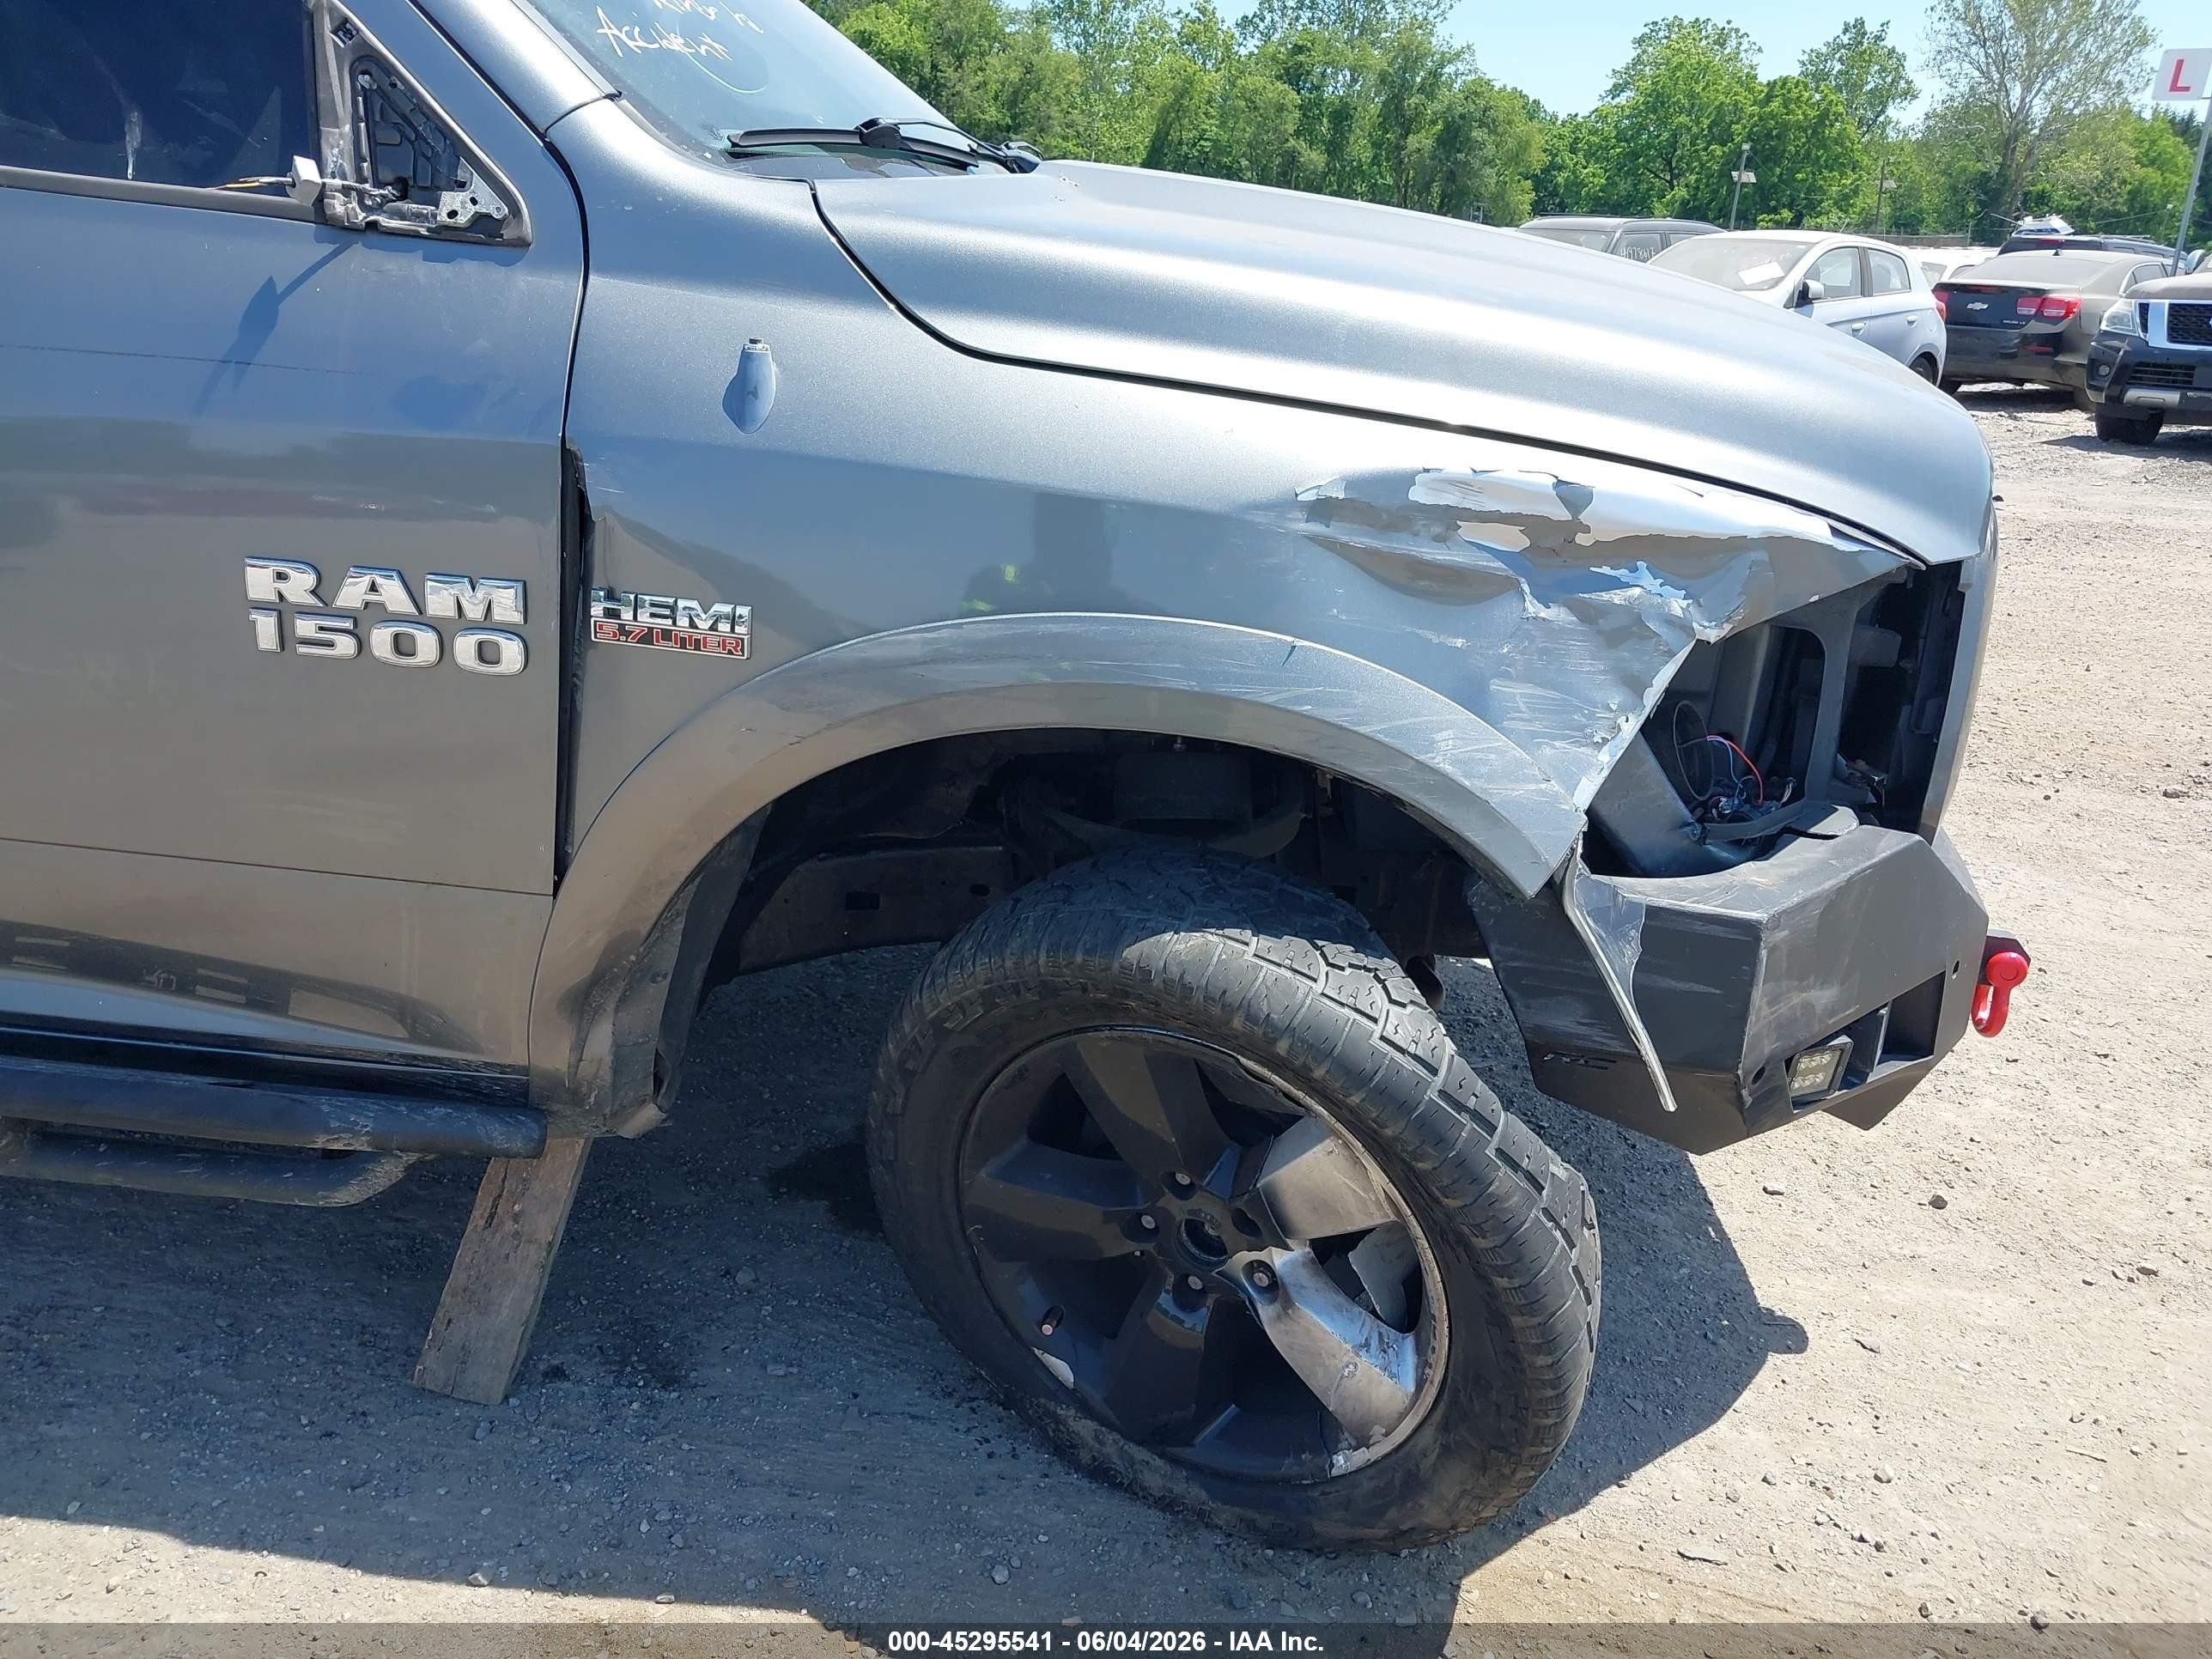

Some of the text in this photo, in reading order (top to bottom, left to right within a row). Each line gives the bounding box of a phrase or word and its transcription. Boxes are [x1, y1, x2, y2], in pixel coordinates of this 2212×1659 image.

[2168, 58, 2191, 93] L
[245, 556, 526, 625] RAM
[590, 588, 753, 634] HEMI
[248, 608, 529, 676] 1500
[596, 622, 743, 656] 5.7 LITER
